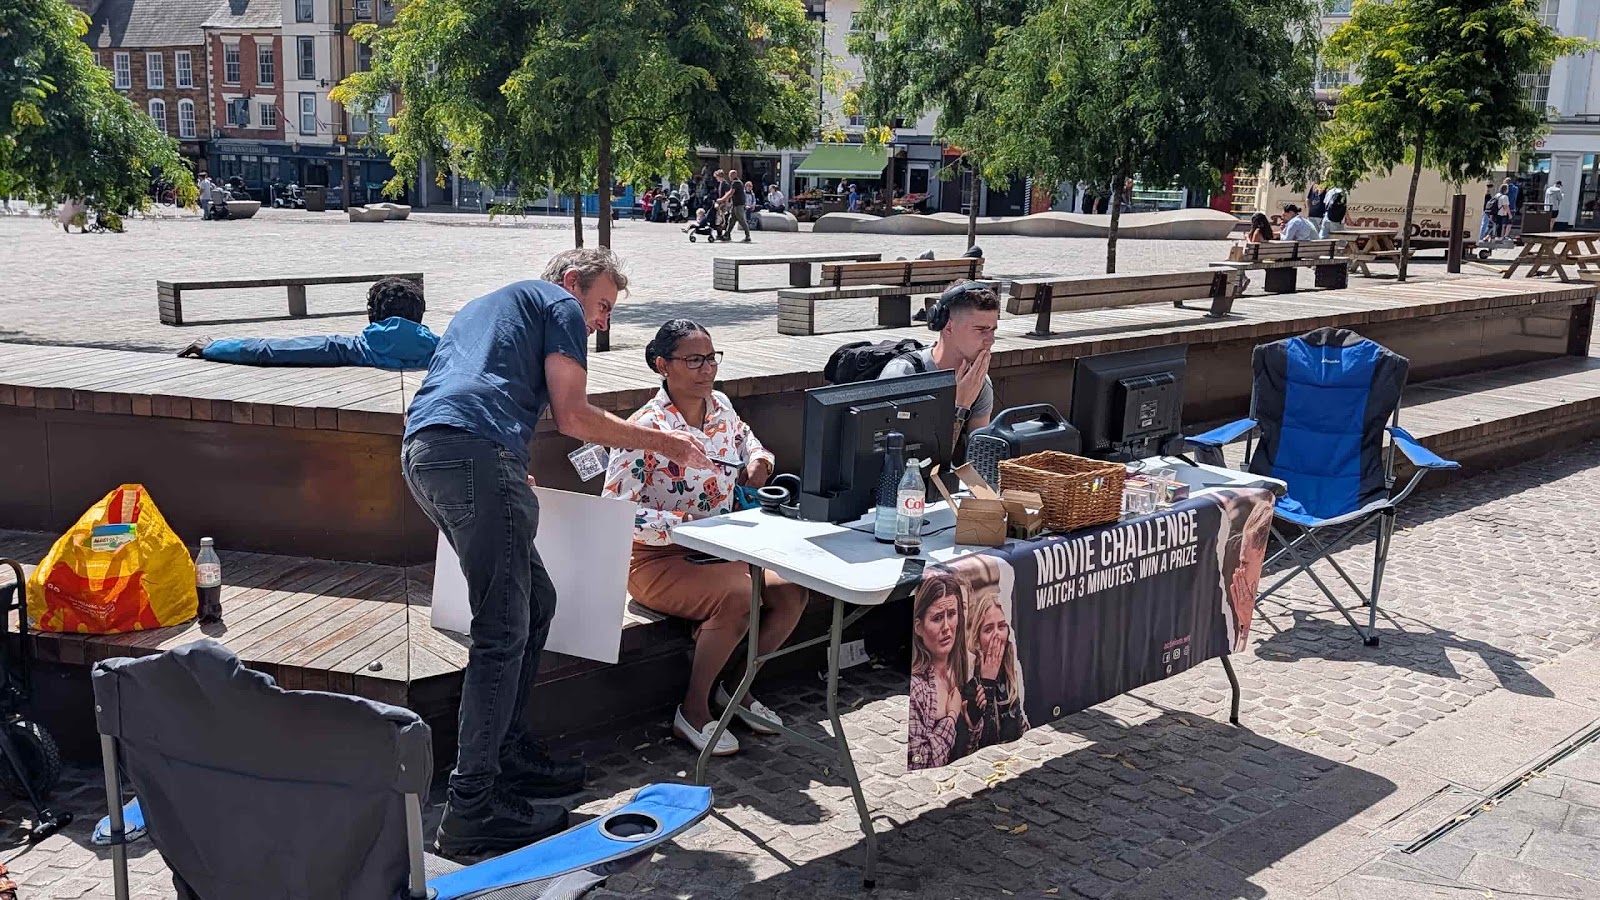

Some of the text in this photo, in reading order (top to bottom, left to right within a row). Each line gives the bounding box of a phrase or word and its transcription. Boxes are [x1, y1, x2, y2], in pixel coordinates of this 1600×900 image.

[1409, 223, 1471, 238] Donus
[1033, 509, 1198, 586] MOVIE CHALLENGE
[1036, 544, 1197, 611] WATCH 3 MINUTES, WIN A PRIZE
